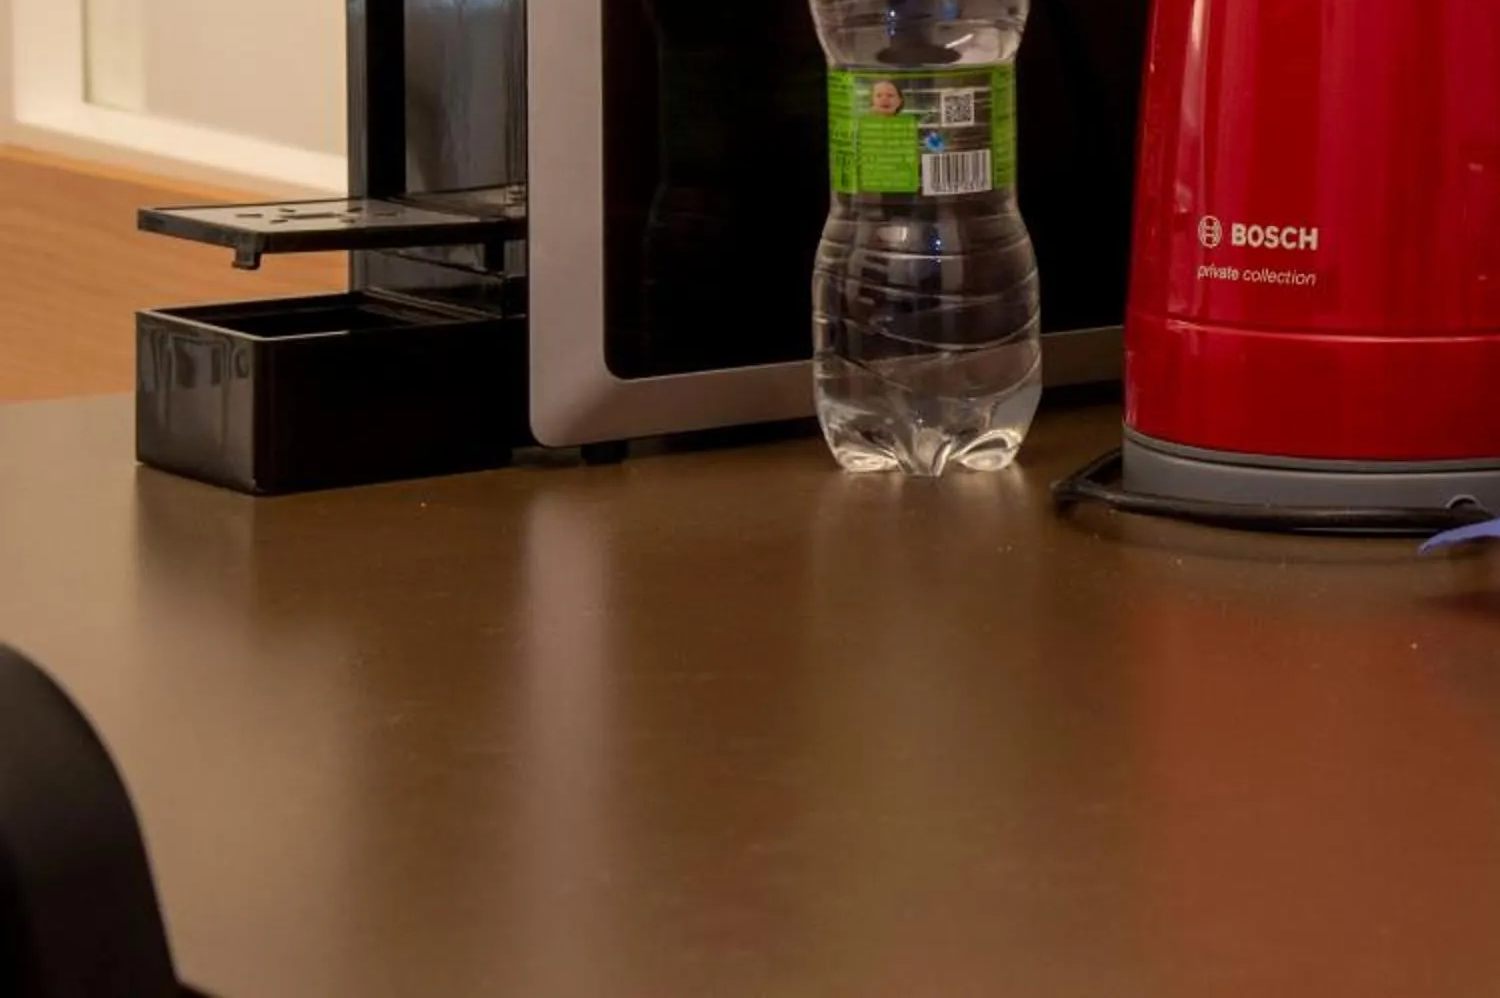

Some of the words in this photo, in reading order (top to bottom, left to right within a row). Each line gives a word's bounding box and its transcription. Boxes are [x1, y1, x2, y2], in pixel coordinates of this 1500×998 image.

[1231, 222, 1319, 251] BOSCH
[1197, 263, 1239, 281] private
[1242, 267, 1317, 286] collection
